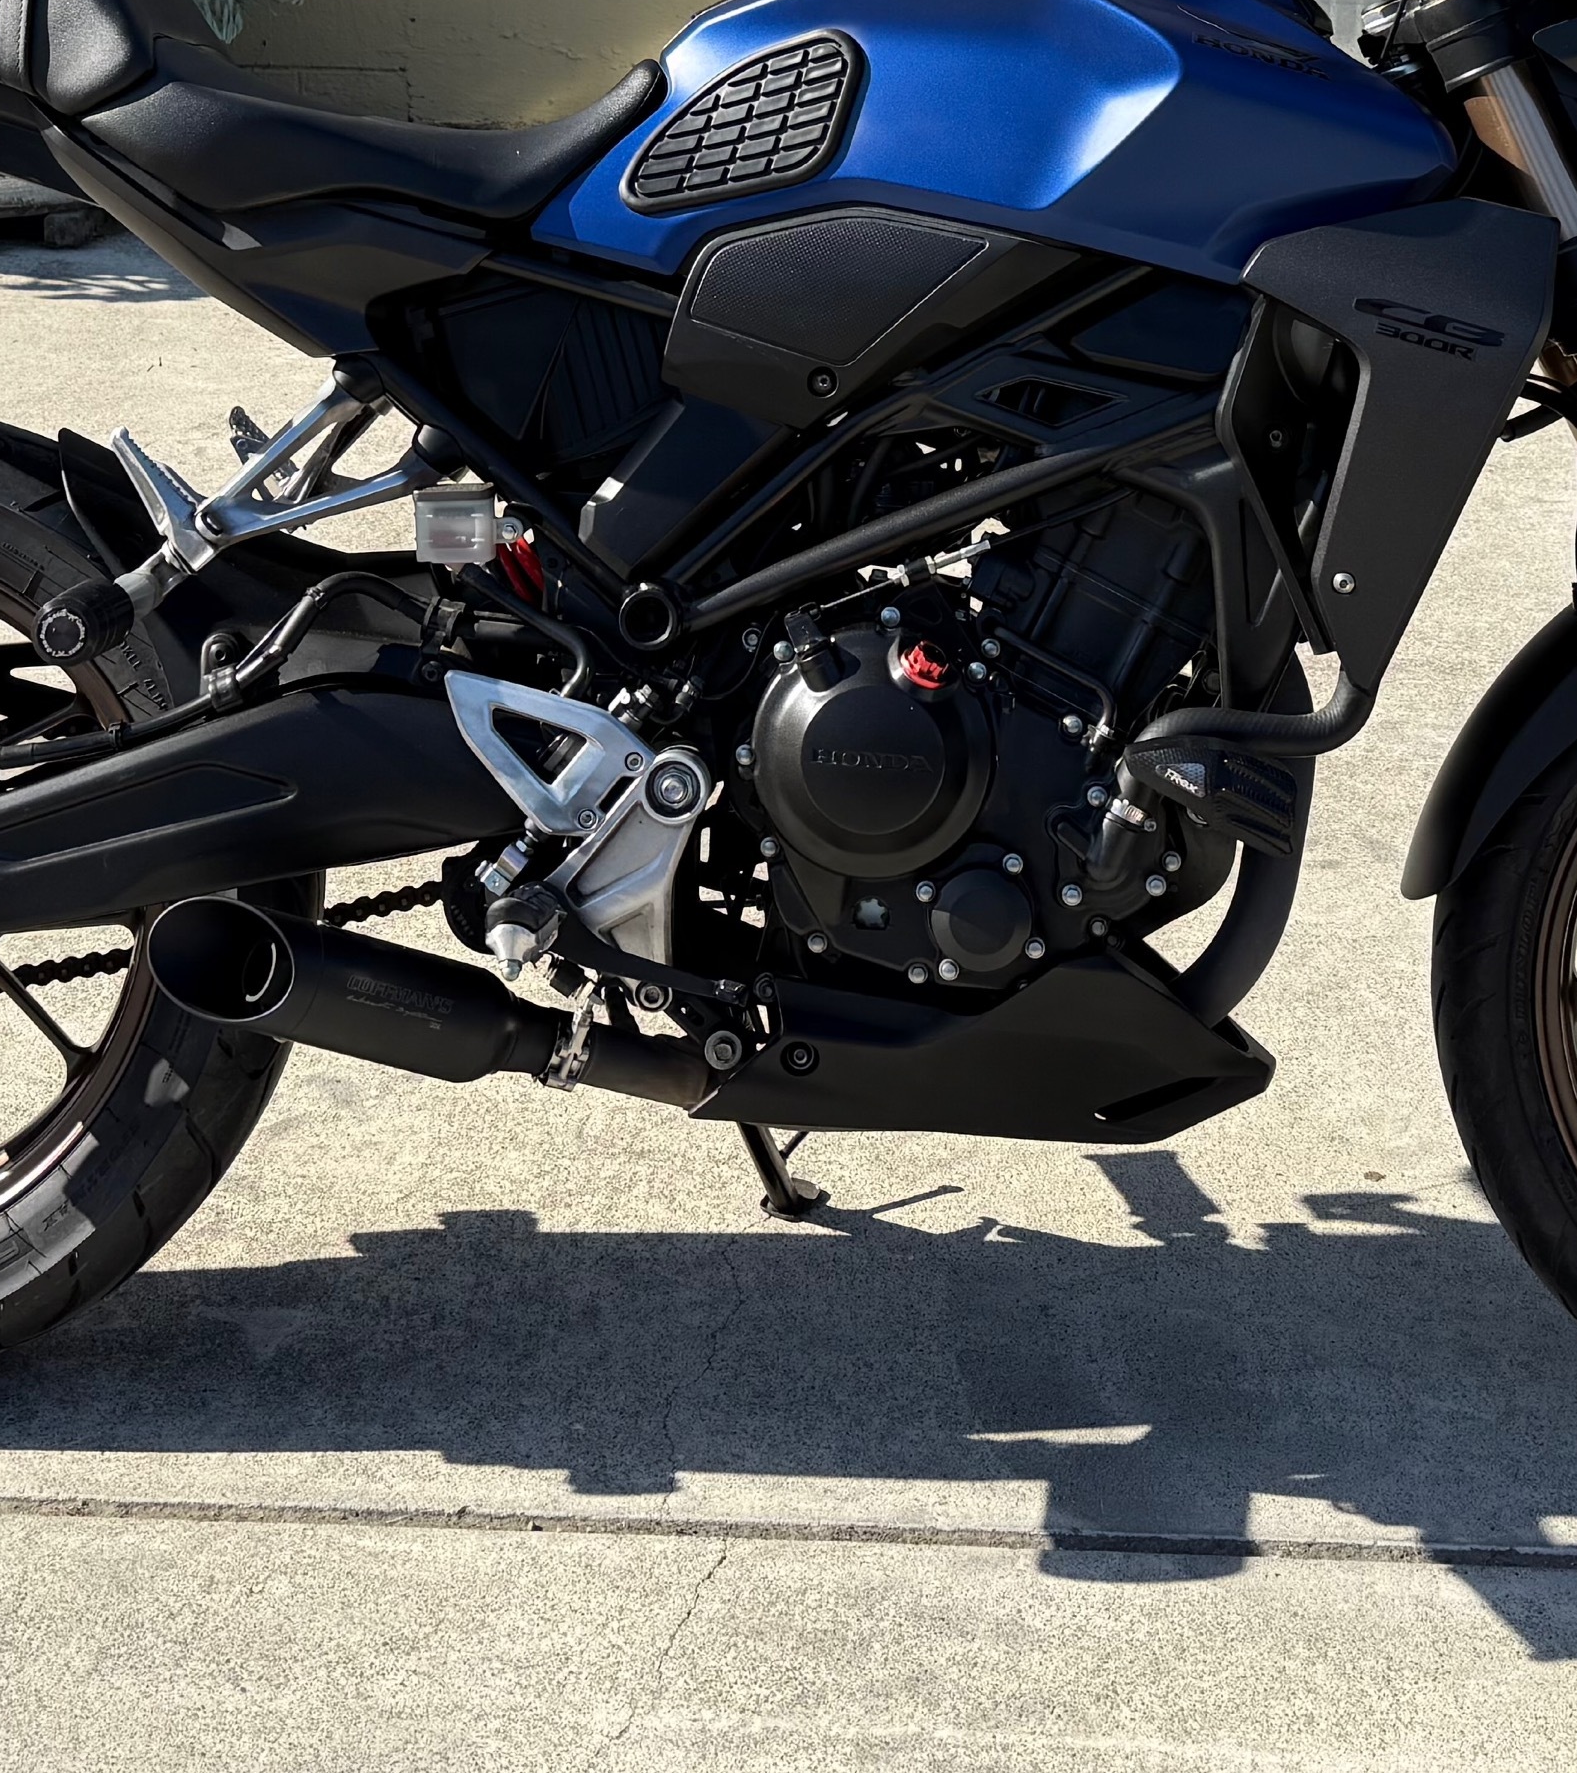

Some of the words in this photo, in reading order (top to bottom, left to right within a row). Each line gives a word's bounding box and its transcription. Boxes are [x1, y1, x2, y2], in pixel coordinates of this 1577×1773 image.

[1193, 33, 1332, 82] HONDA
[1354, 298, 1506, 346] CB
[1375, 322, 1478, 361] 300R
[806, 747, 935, 774] HONDA
